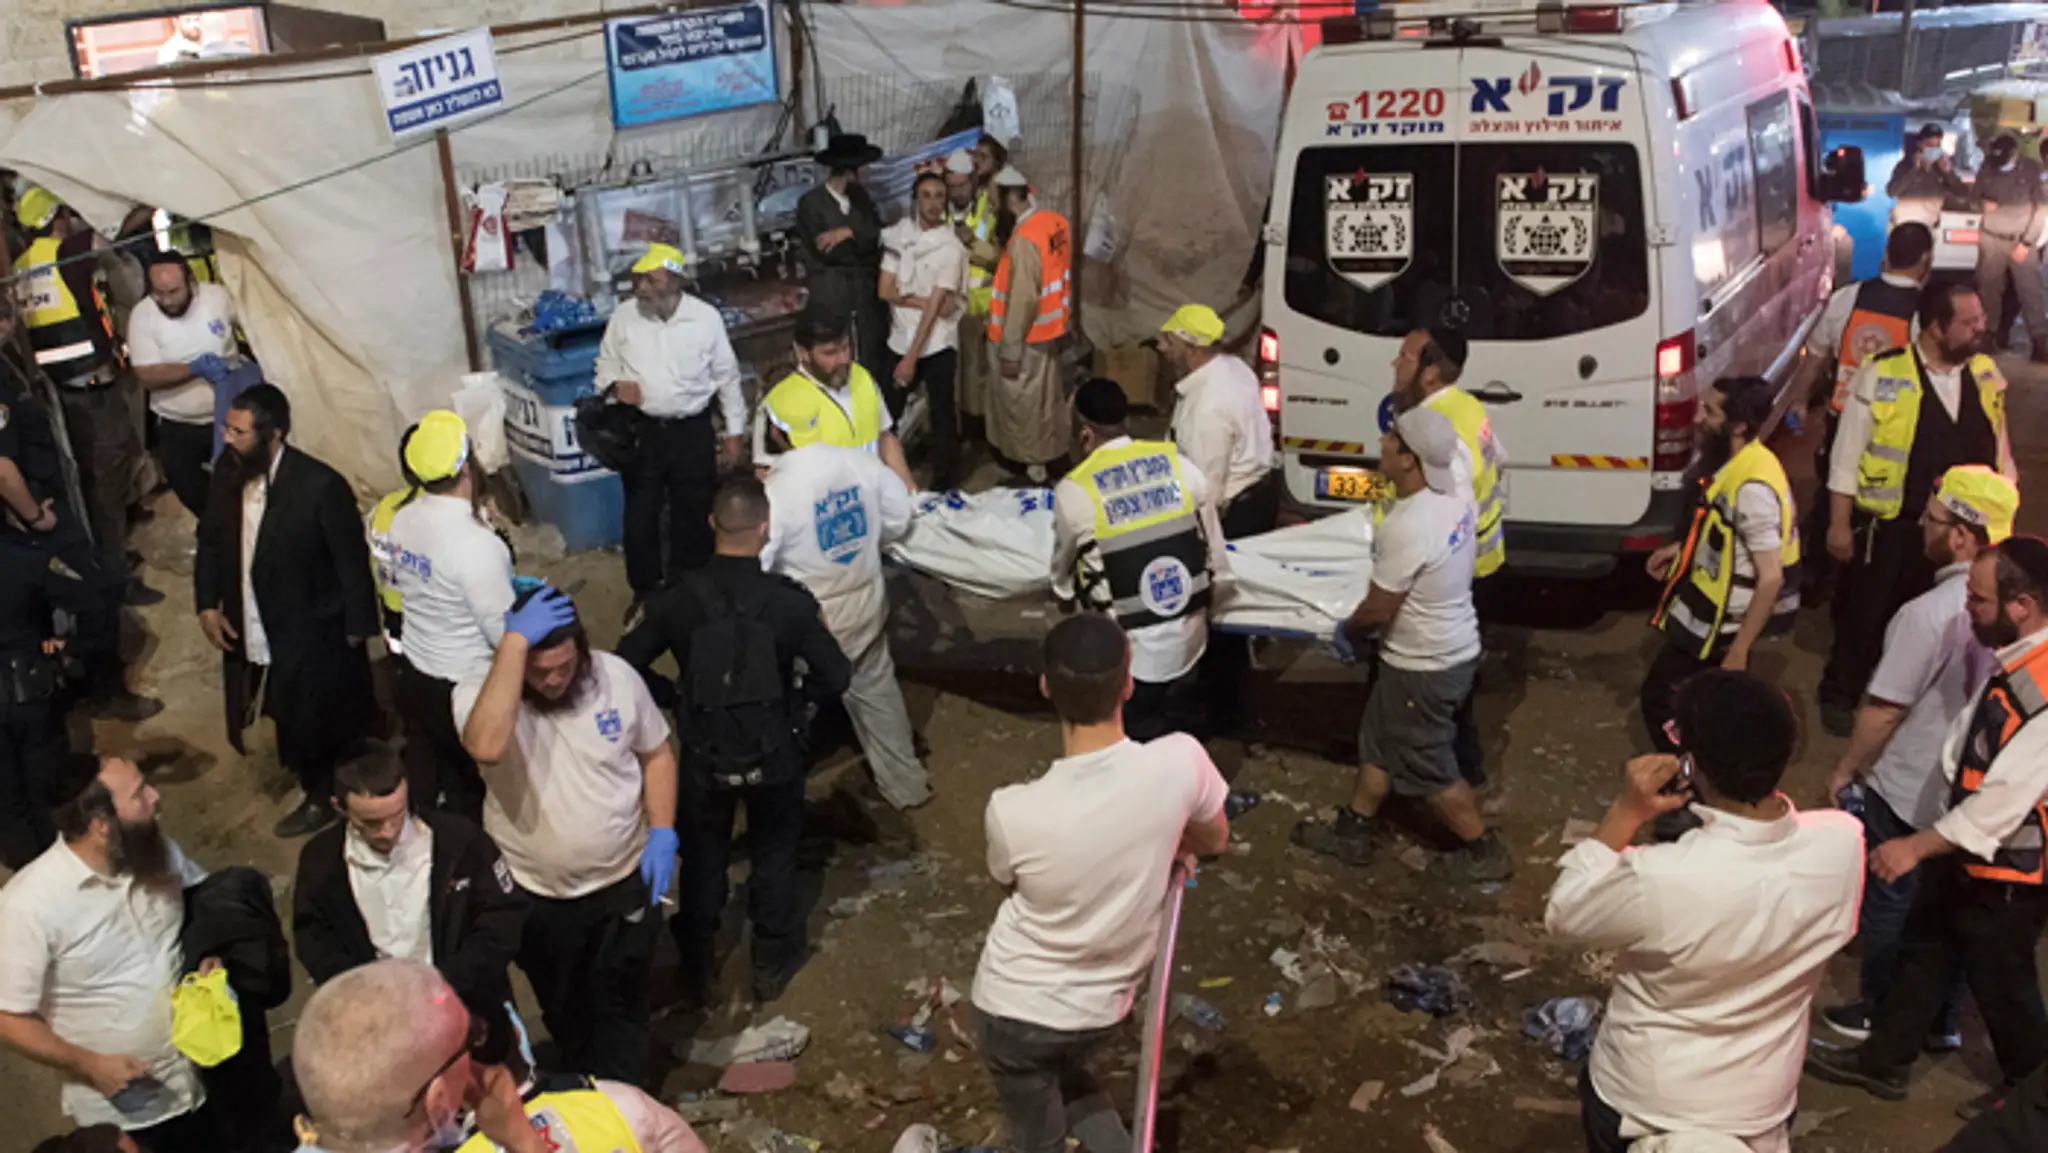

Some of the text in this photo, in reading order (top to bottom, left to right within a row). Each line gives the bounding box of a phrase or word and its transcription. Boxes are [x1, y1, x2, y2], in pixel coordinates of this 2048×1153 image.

[398, 46, 475, 92] גניזה
[1354, 88, 1445, 119] 1220
[1386, 121, 1444, 136] מוקד
[1469, 117, 1622, 135] איתור חילוץ והצלה
